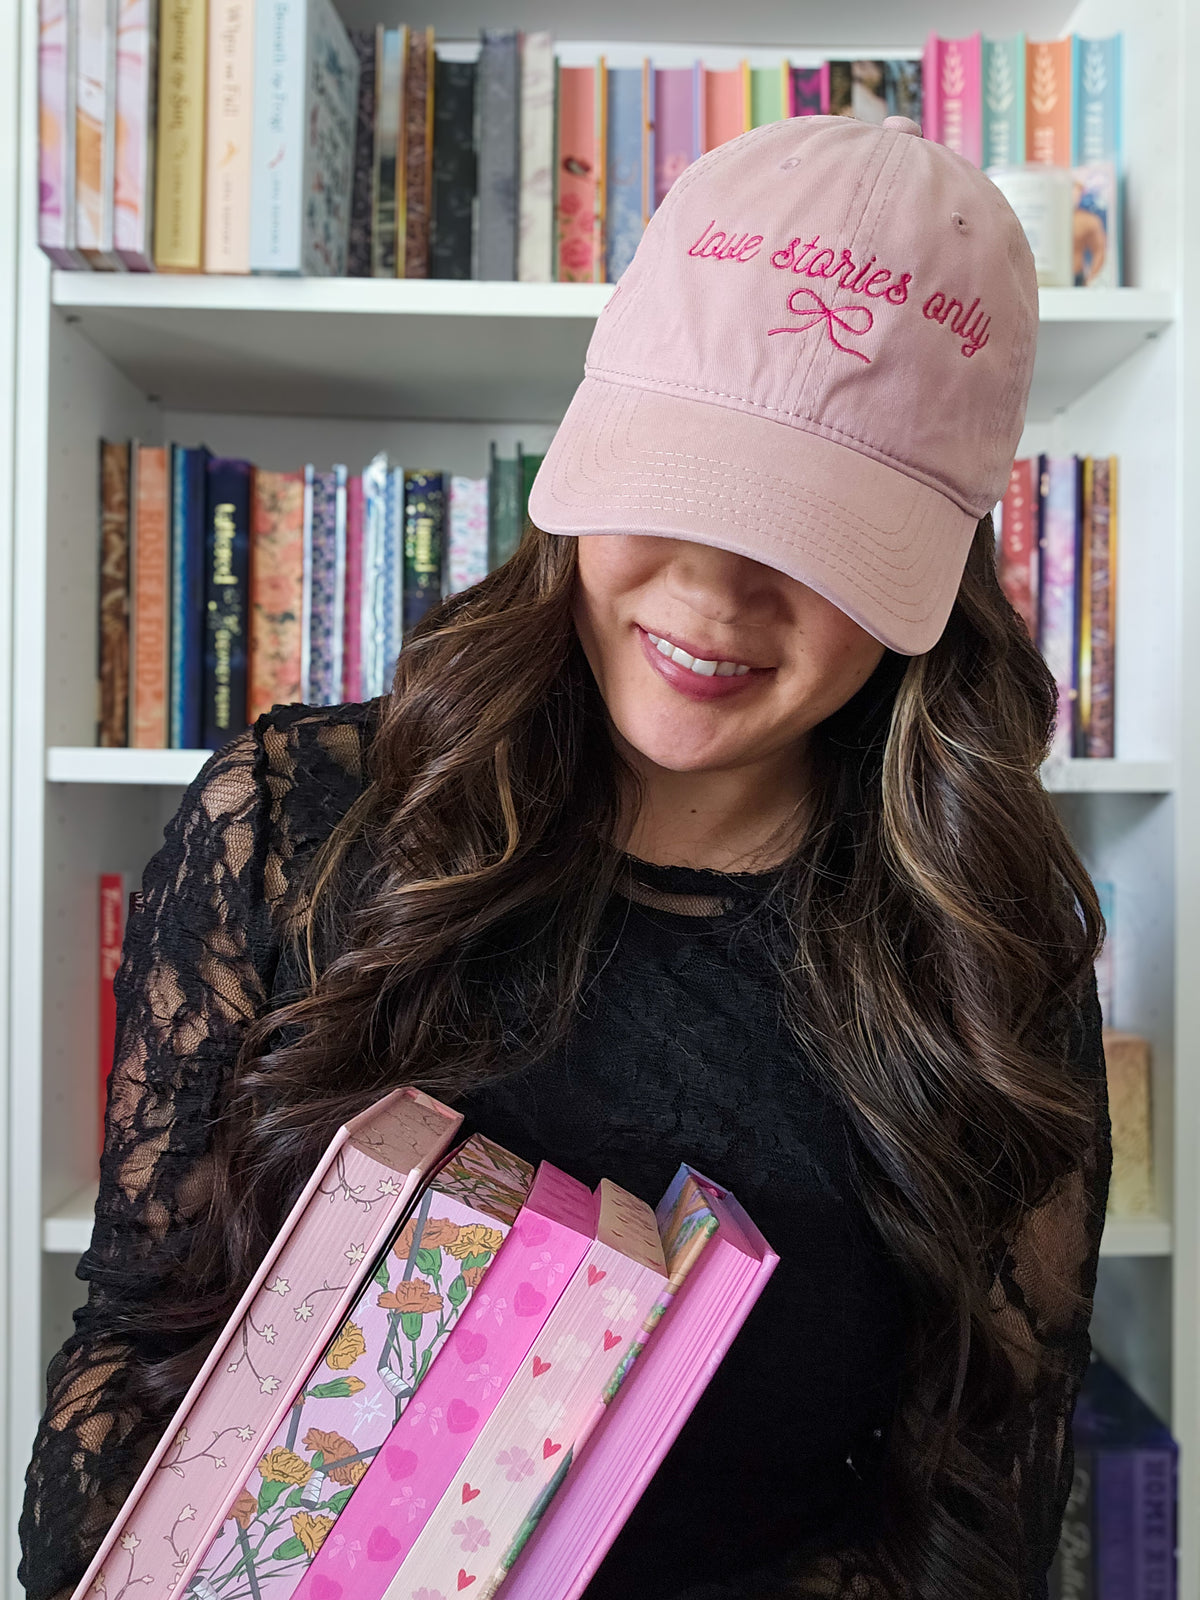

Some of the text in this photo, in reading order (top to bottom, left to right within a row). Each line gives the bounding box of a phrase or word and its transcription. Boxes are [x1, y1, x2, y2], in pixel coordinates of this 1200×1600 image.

[688, 220, 992, 358] love stories only
[137, 509, 165, 588] ROSIE
[135, 616, 164, 687] FORD
[1143, 1460, 1167, 1540] HOME
